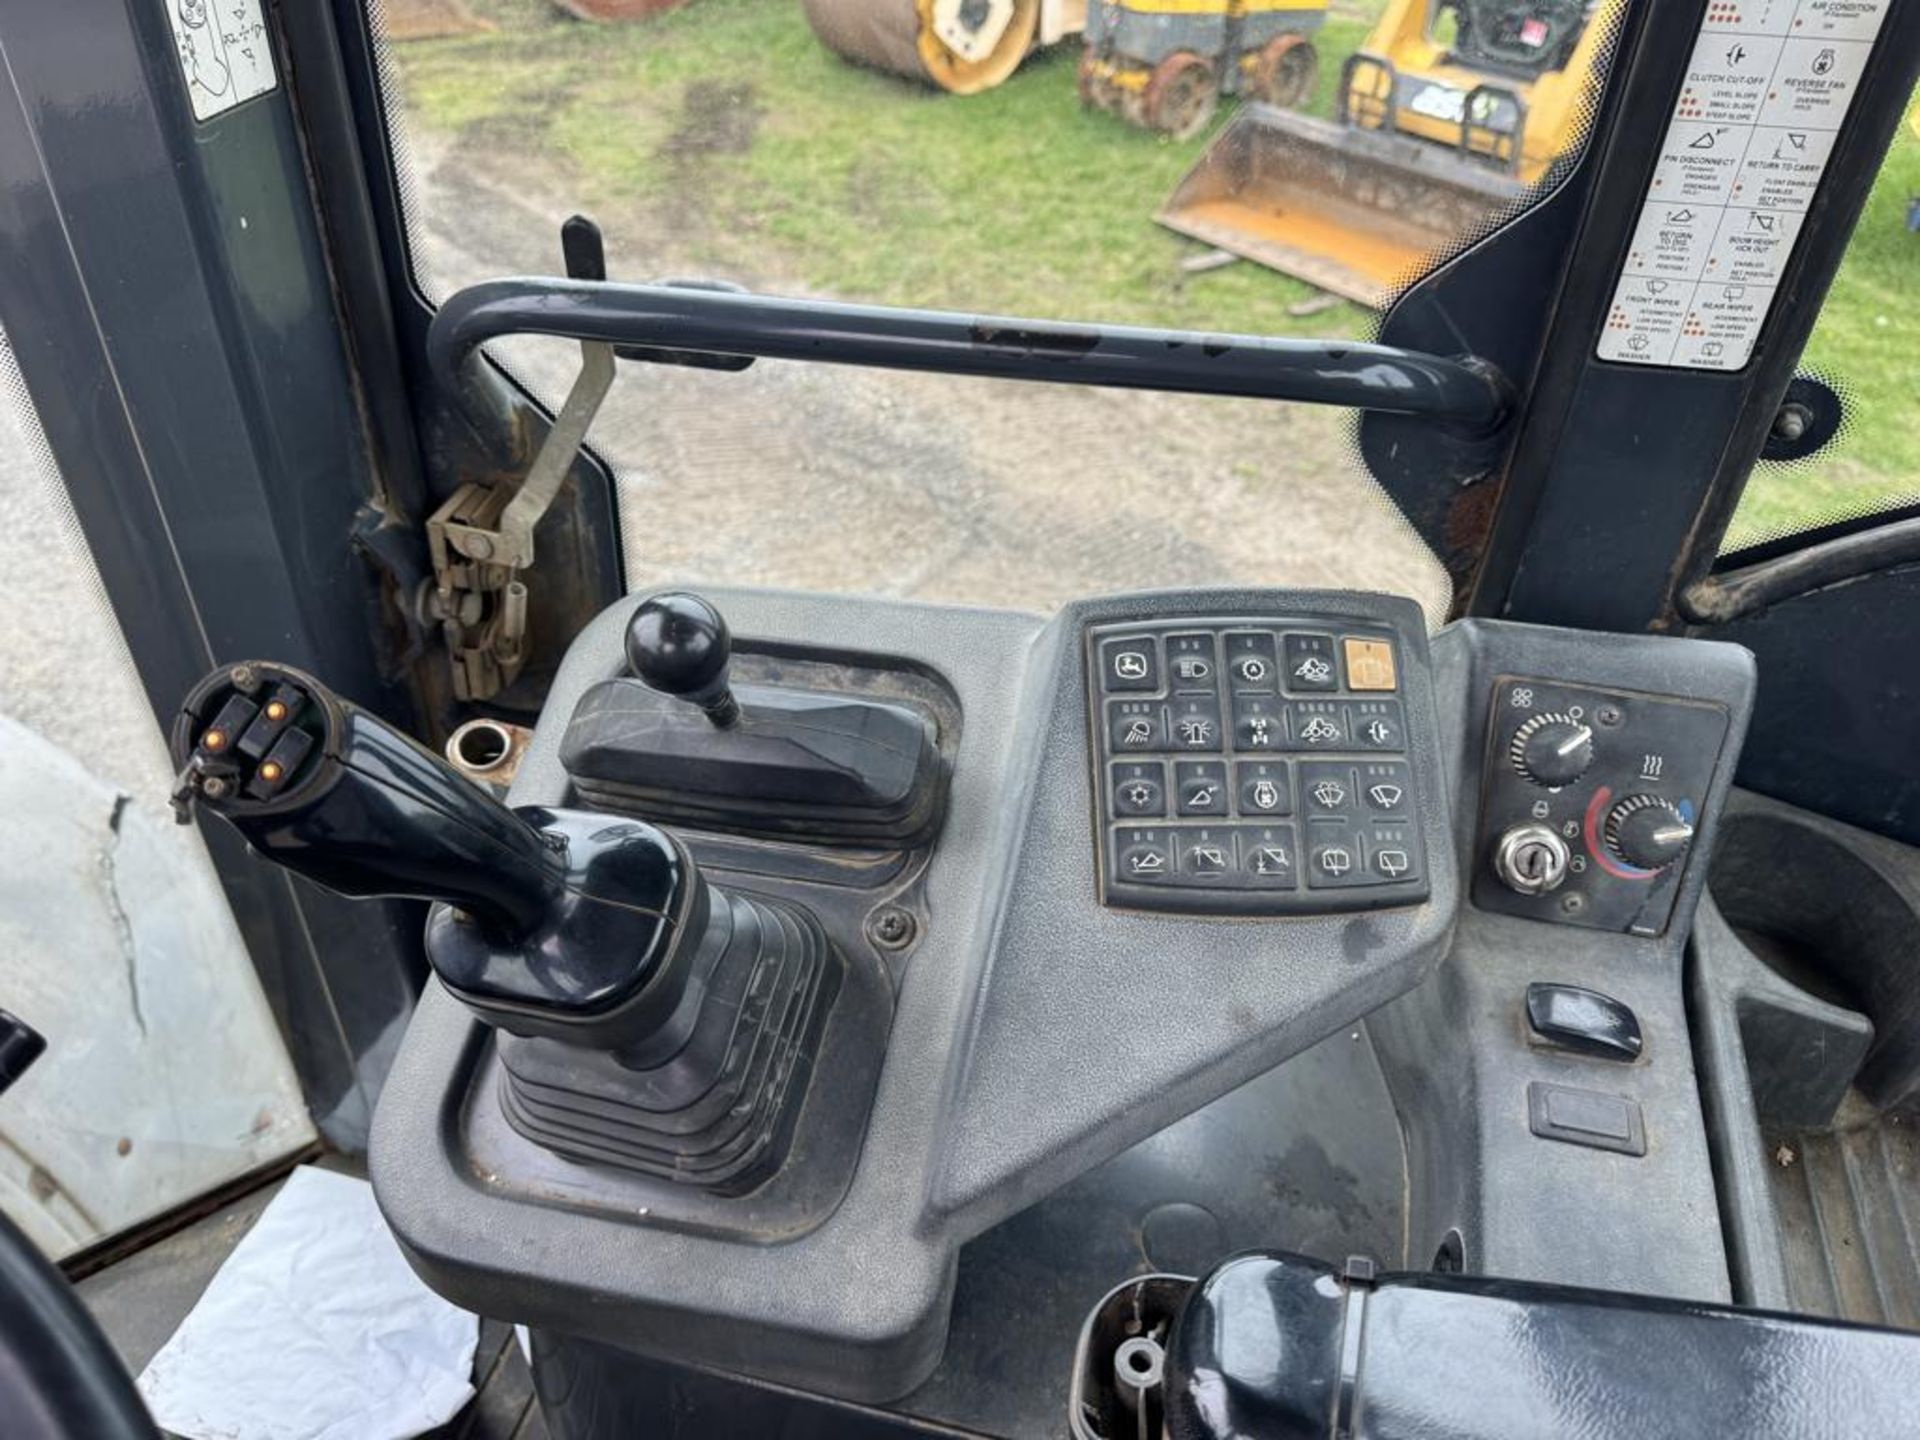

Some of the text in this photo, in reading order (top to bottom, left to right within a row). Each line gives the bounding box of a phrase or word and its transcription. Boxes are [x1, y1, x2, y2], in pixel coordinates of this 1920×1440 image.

[1829, 2, 1878, 12] CONDITION
[1690, 72, 1766, 85] CLUTCH CUT-OFF
[1784, 78, 1825, 88] REVERSE
[1679, 156, 1736, 167] DISCONNECT
[1747, 160, 1780, 170] RETURN
